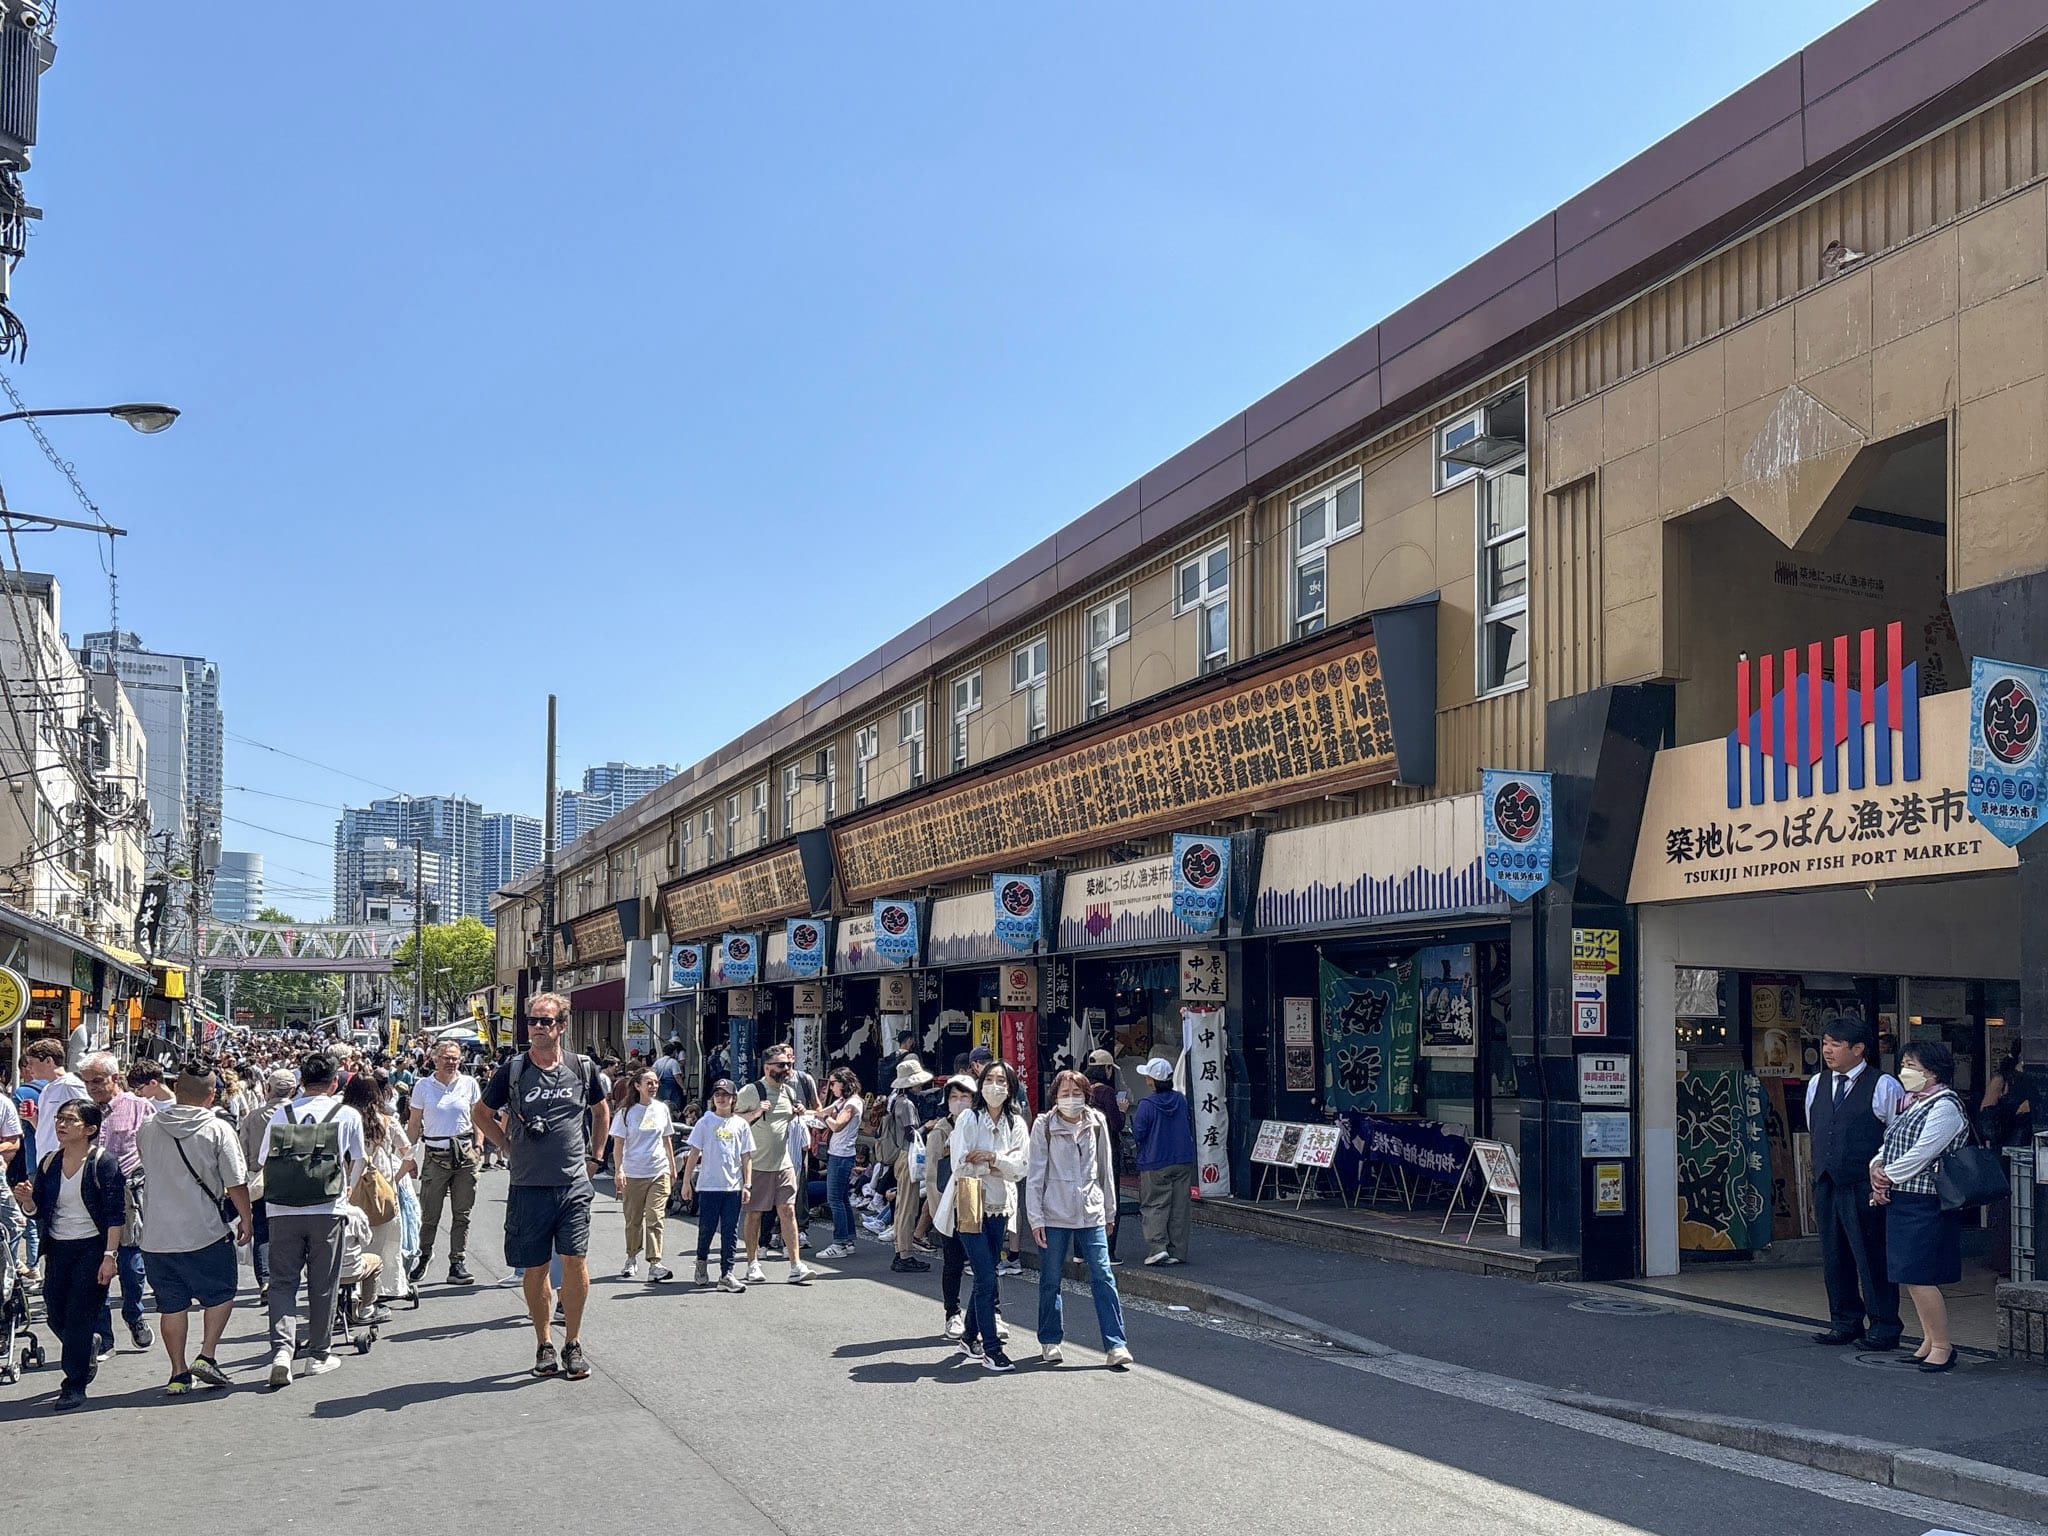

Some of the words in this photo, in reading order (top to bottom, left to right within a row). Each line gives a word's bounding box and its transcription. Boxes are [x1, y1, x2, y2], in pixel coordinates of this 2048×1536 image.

[1316, 694, 1342, 769] 築地不動産
[1981, 802, 2038, 819] 築地場外市場
[1684, 867, 1738, 884] TSUKIJI
[1742, 861, 1800, 880] NIPPON
[1806, 855, 1844, 872] FISH
[1851, 850, 1896, 866] PORT
[1903, 840, 1982, 862] MARKET
[1584, 930, 1617, 946] コイン
[1574, 945, 1617, 959] ロッカー
[1056, 962, 1070, 1010] 北海道
[1574, 974, 1604, 982] Exchange
[927, 974, 938, 1000] 高知
[541, 1086, 573, 1100] asics
[1198, 1028, 1220, 1147] 中原水産
[1313, 1151, 1330, 1163] SALE
